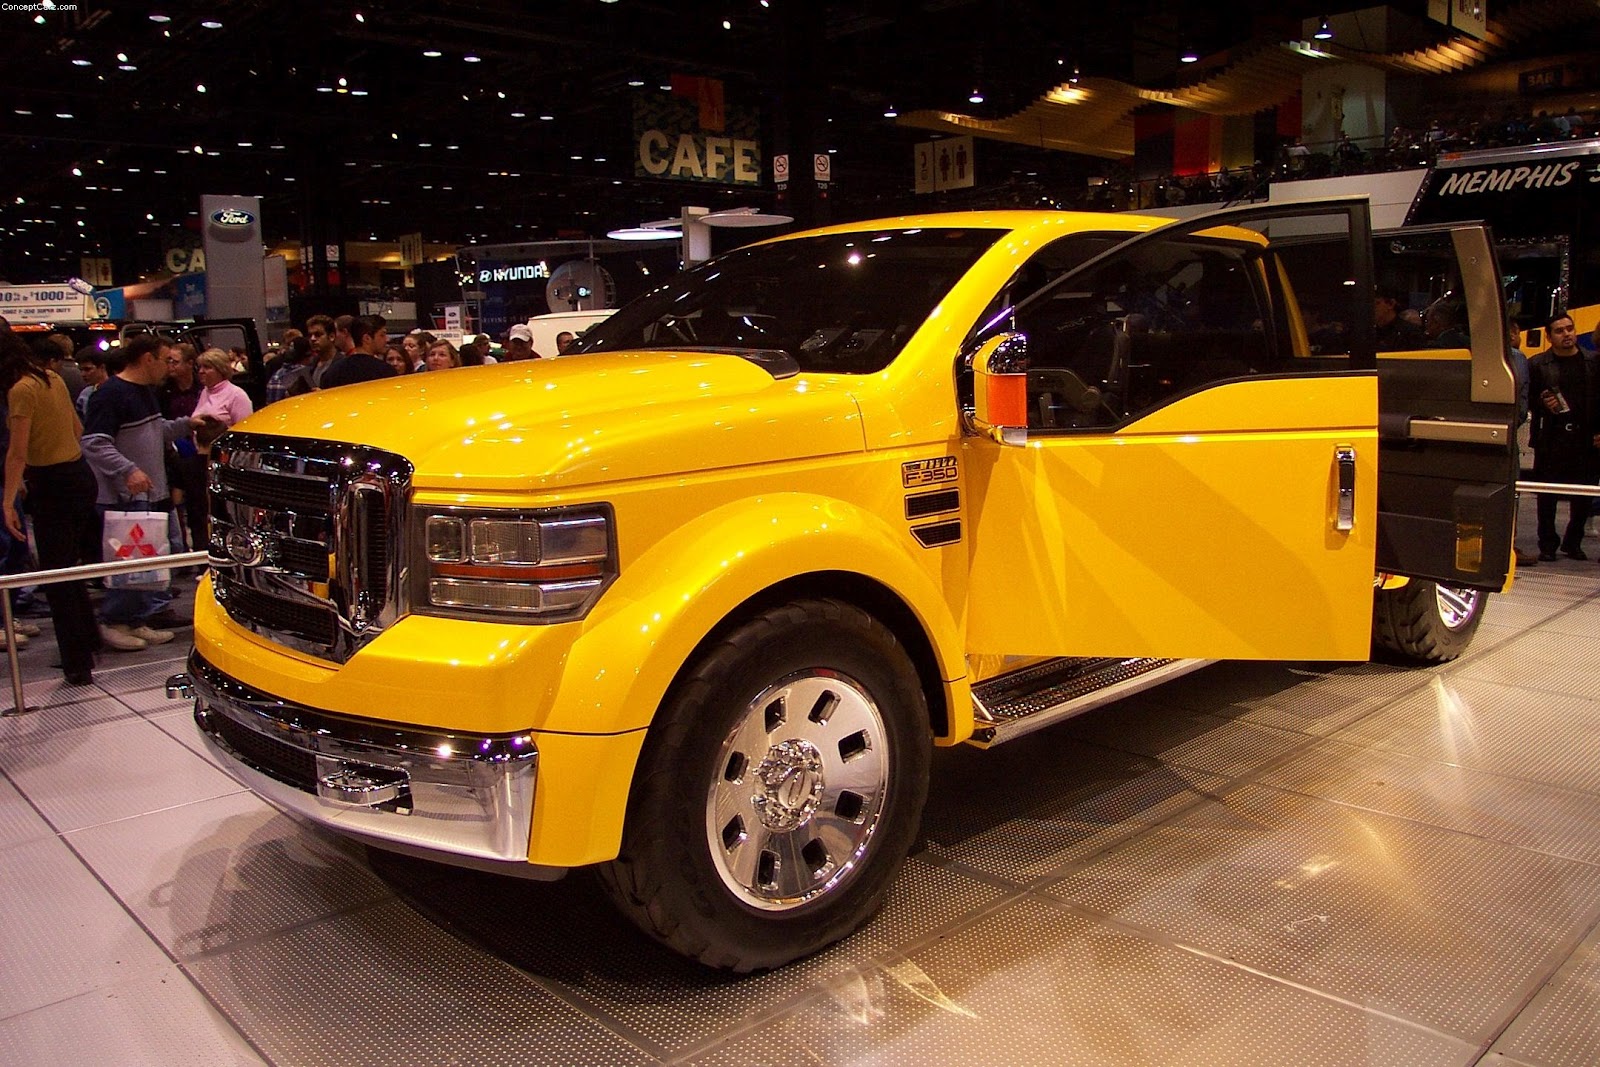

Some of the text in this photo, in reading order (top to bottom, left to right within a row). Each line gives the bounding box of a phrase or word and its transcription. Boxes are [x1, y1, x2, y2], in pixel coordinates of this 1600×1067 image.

[639, 128, 758, 182] CAFE
[1438, 161, 1581, 196] MEMPHIS
[220, 210, 249, 224] Ford
